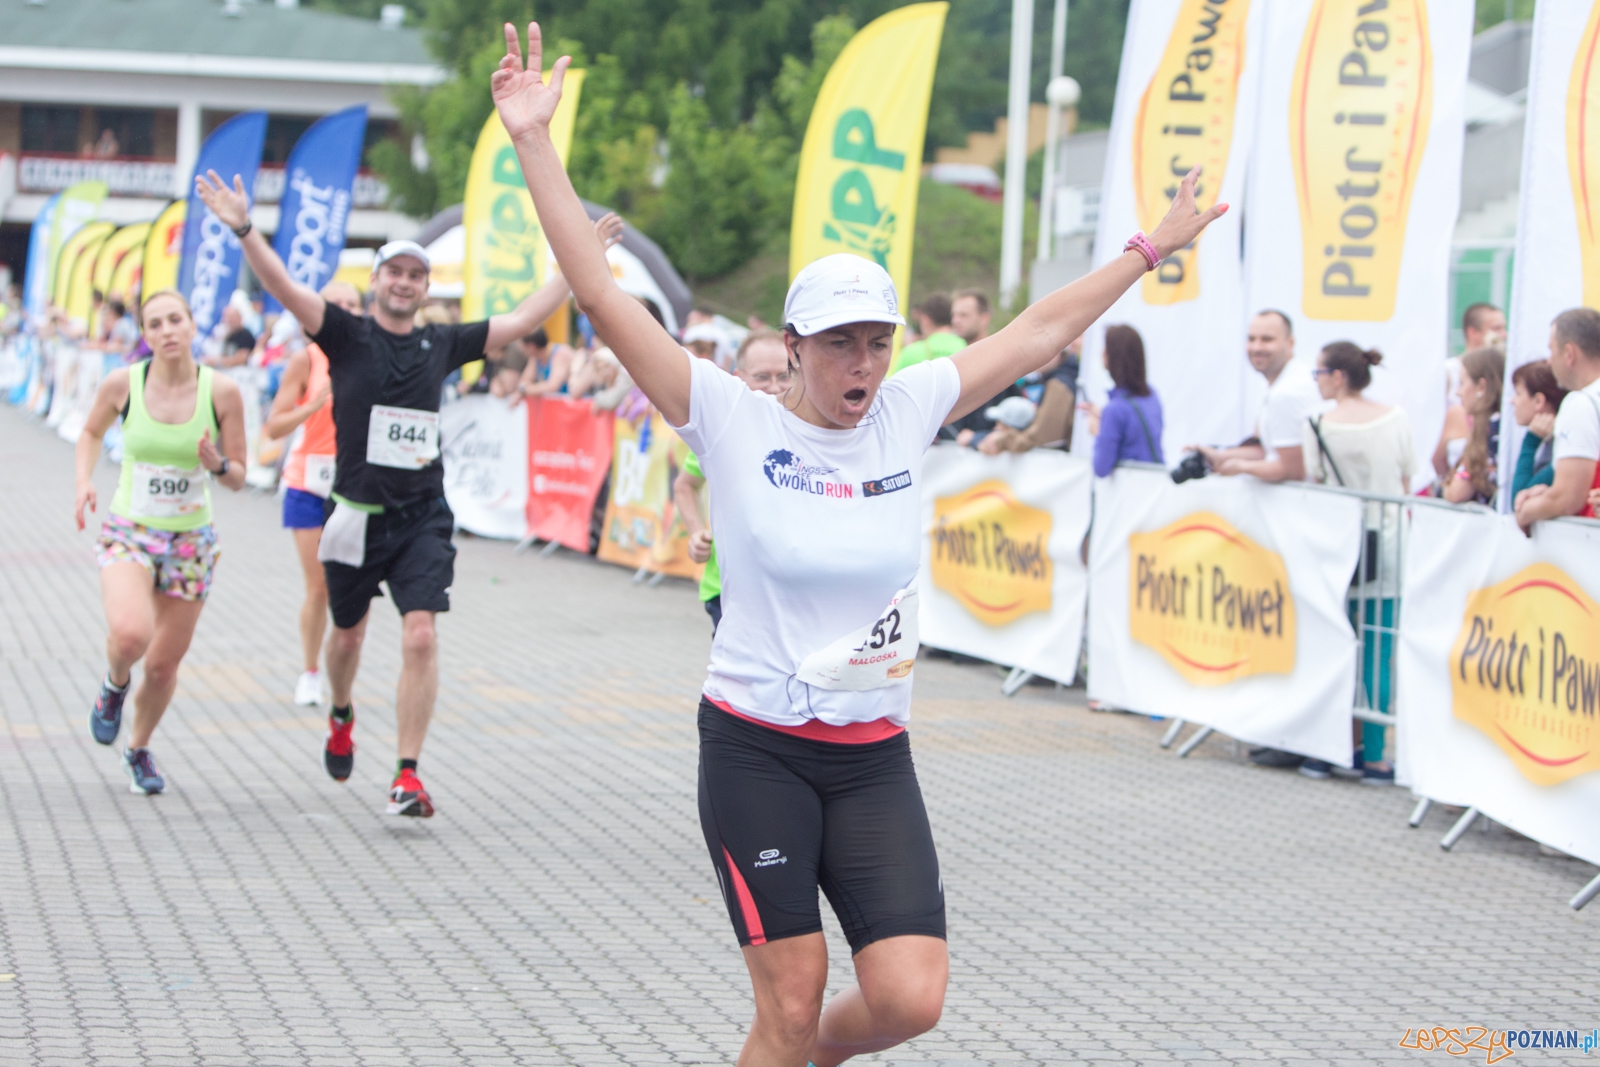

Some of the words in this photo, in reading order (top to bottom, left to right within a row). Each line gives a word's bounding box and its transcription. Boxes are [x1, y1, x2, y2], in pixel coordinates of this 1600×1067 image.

[1168, 0, 1228, 102] Paw
[1333, 111, 1388, 126] i
[1320, 145, 1384, 298] Piotr
[387, 423, 427, 444] 844
[148, 478, 189, 495] 590
[777, 471, 824, 496] WORLD
[825, 482, 853, 499] RUN
[881, 471, 911, 492] SATURN
[1136, 554, 1190, 618] Piotr
[1197, 561, 1204, 622] i
[1212, 565, 1286, 640] Paweł
[1460, 615, 1530, 698] Piotr
[1537, 626, 1545, 703] i
[1551, 631, 1600, 720] Paw
